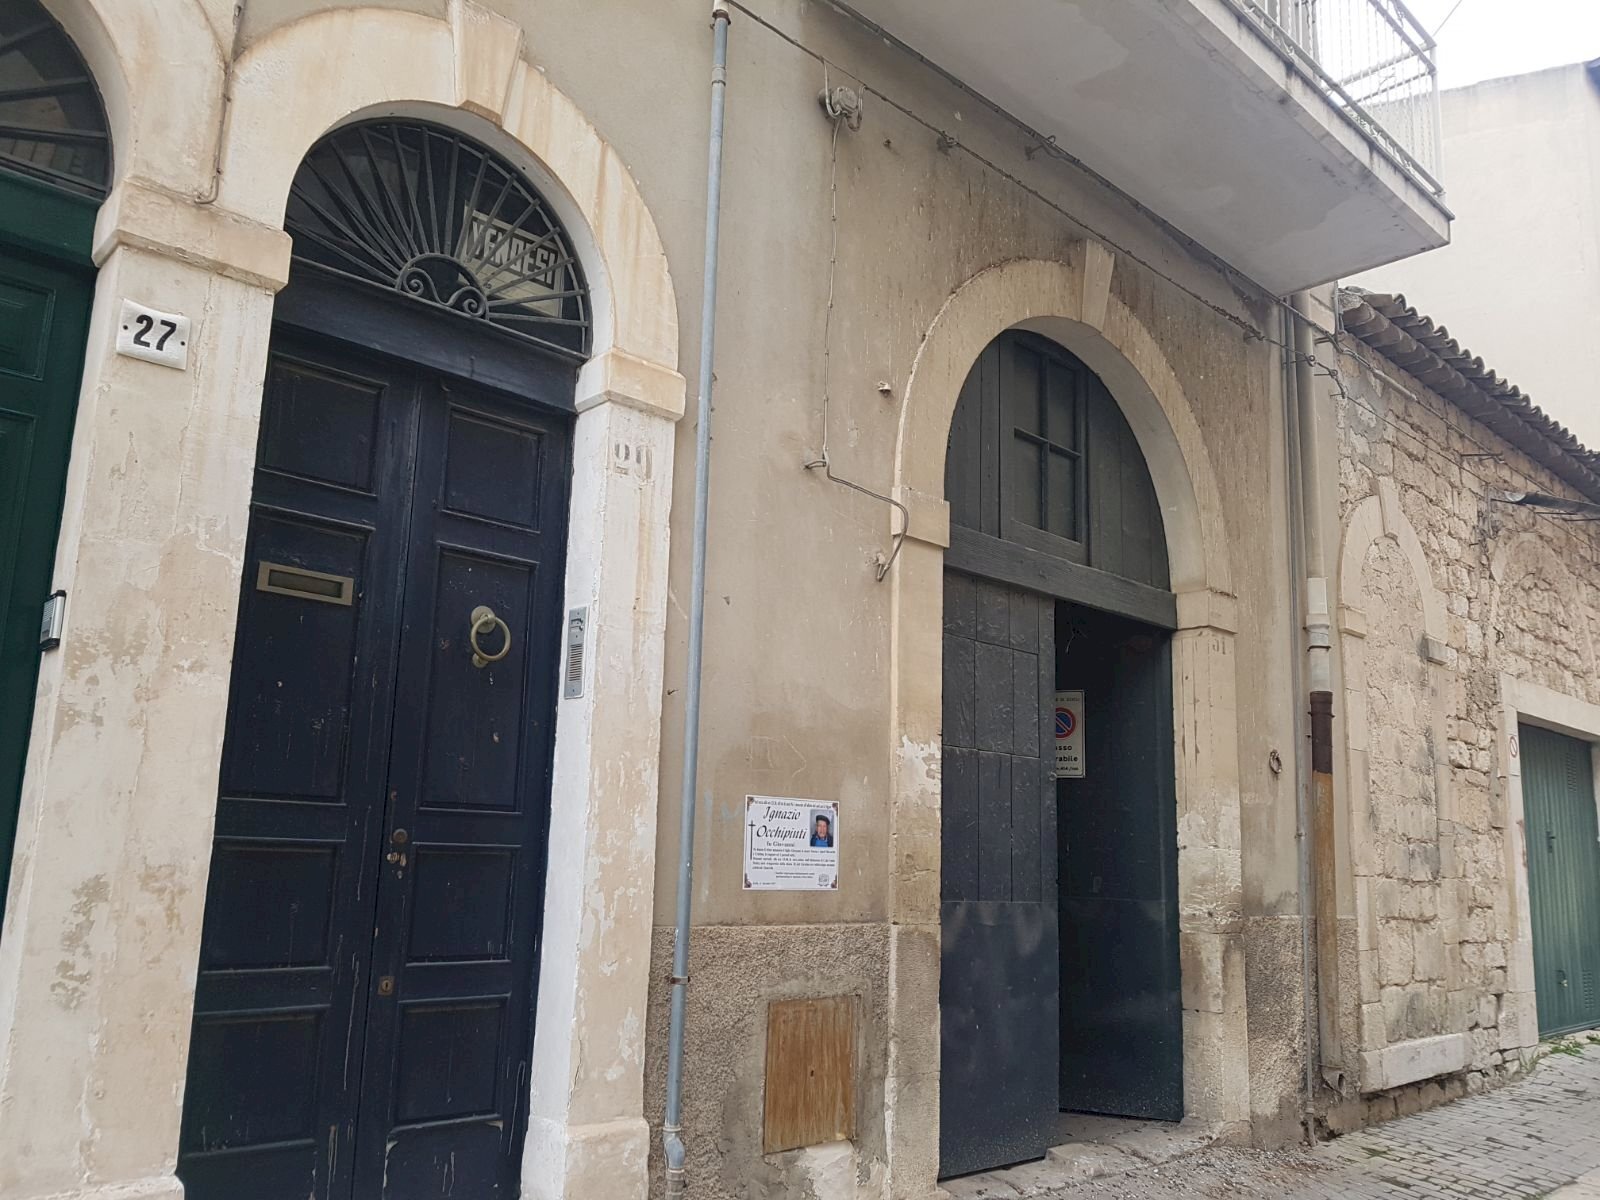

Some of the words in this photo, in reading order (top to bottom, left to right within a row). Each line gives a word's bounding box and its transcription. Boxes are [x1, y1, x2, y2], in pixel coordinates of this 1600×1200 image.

[471, 221, 557, 285] VENDESI
[133, 314, 177, 351] 27
[763, 806, 801, 822] Ignazio
[756, 825, 808, 841] Occhipinti
